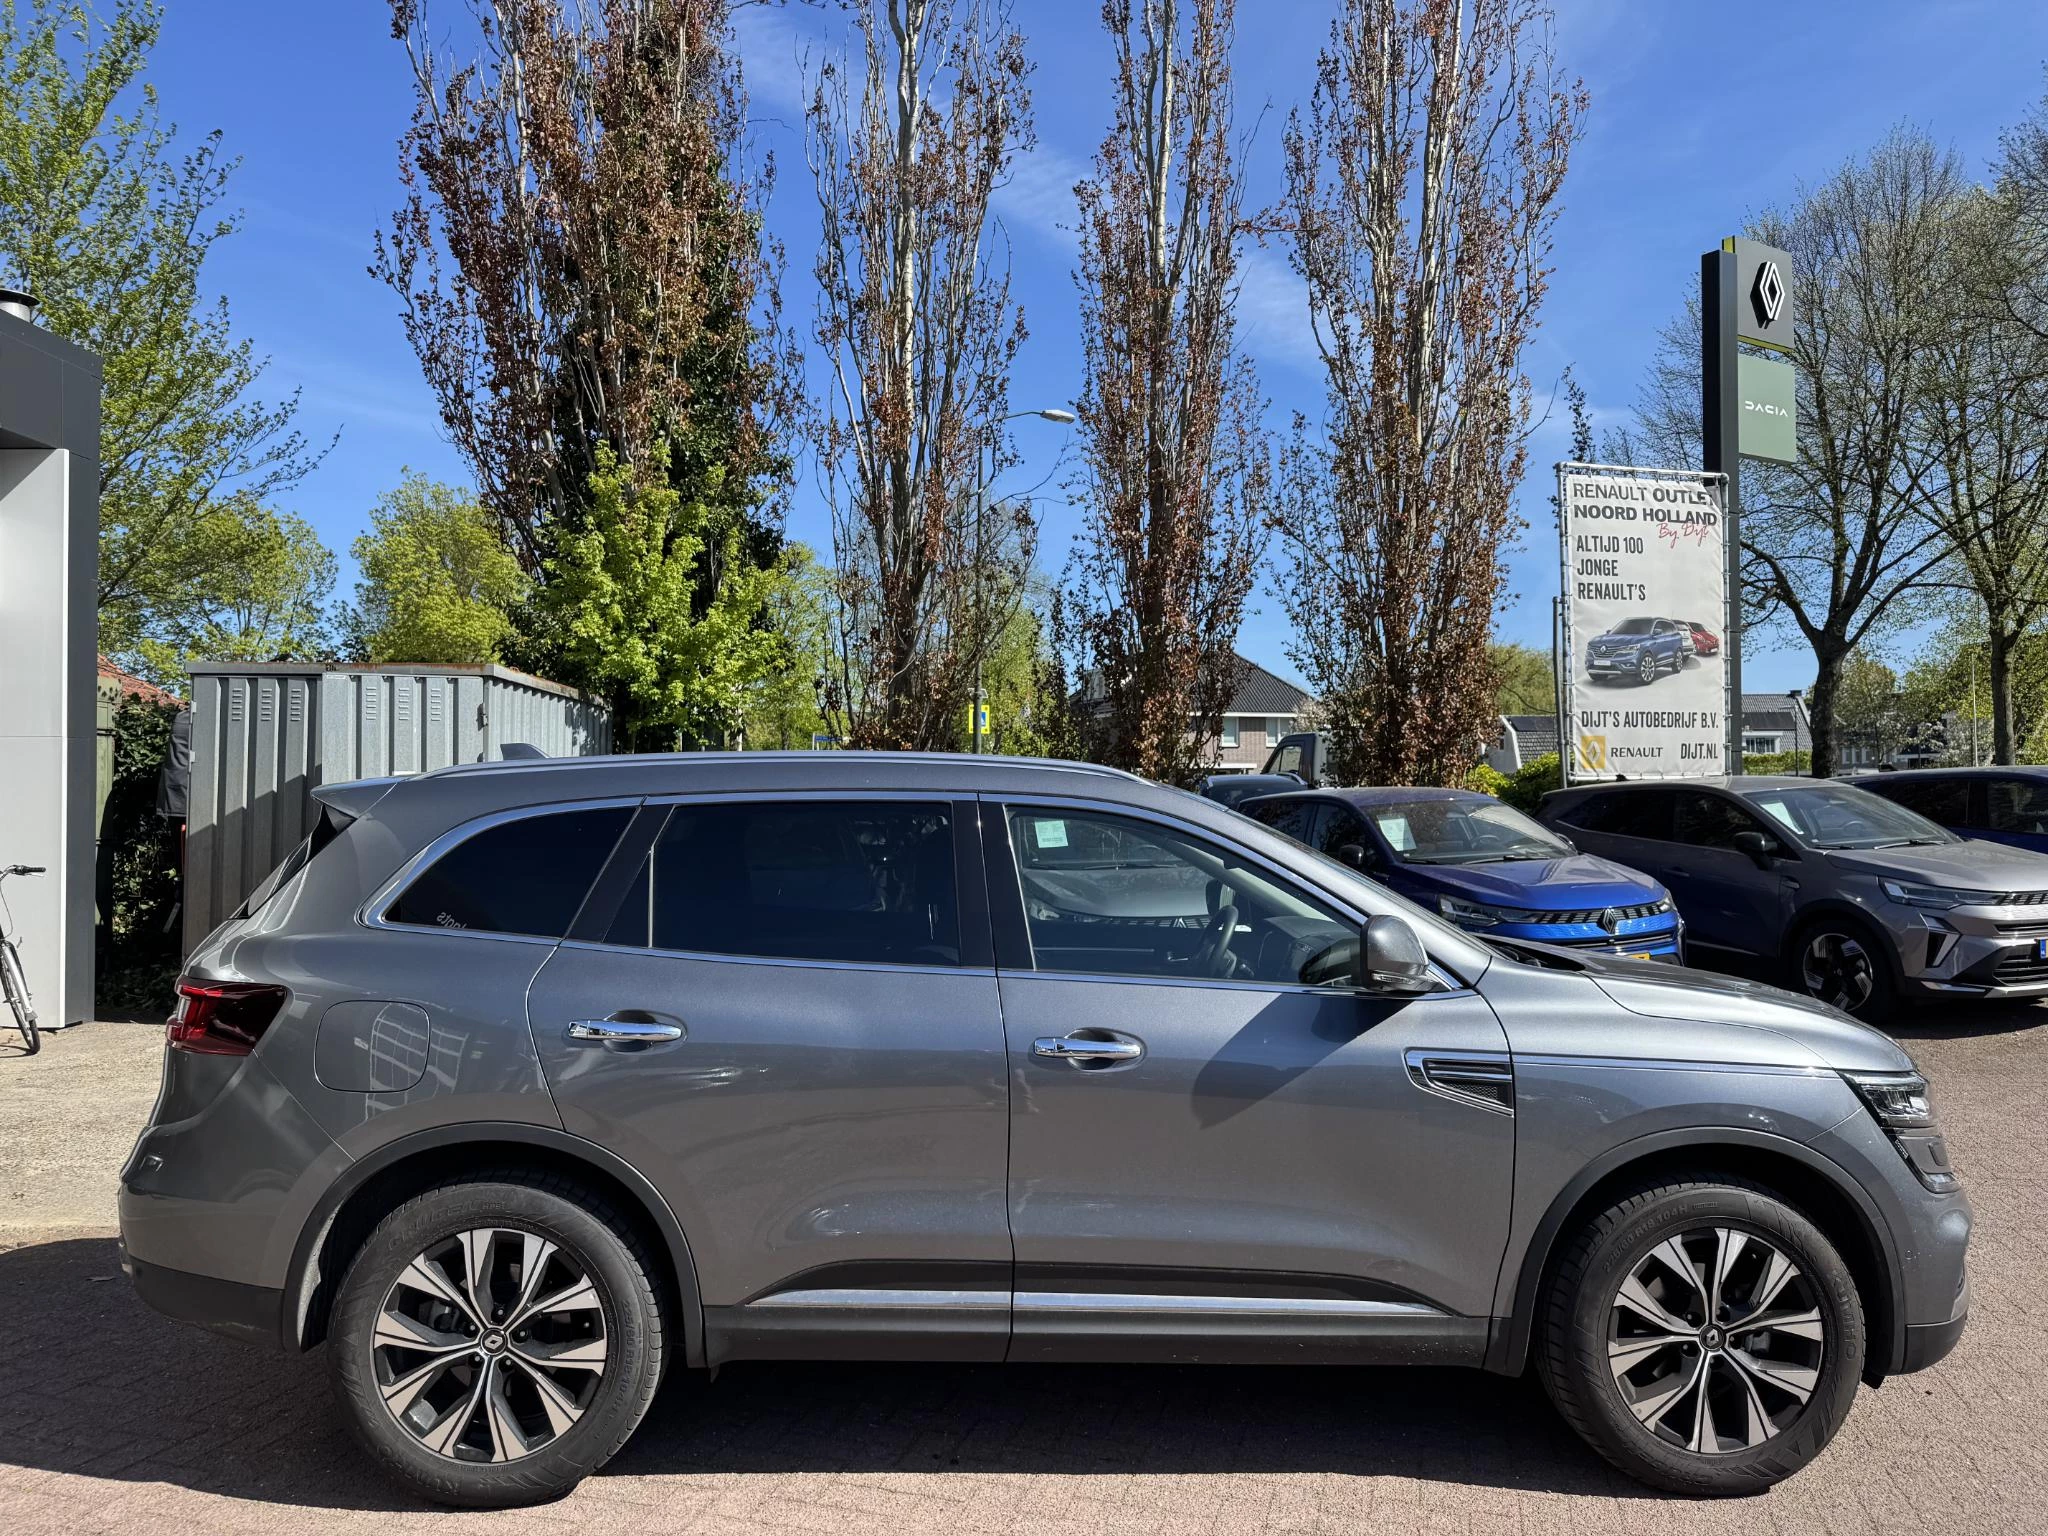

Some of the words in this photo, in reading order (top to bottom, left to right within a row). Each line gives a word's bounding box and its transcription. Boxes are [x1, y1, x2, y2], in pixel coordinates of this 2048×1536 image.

[1745, 400, 1788, 418] DACIA
[1573, 483, 1647, 501] RENAULT
[1574, 504, 1637, 521] NOORD
[1642, 508, 1717, 526] HOLLAND
[1576, 535, 1620, 553] ALTIJD
[1623, 536, 1644, 554] 100
[1577, 559, 1619, 577] JONGE
[1577, 582, 1646, 601] RENAULT'S
[1581, 711, 1620, 728] DIJT'S
[1623, 711, 1697, 729] AUTOBEDRIJF
[1700, 712, 1719, 729] B.V.
[1610, 747, 1663, 758] RENAULT
[1680, 743, 1718, 760] DIJT.NL
